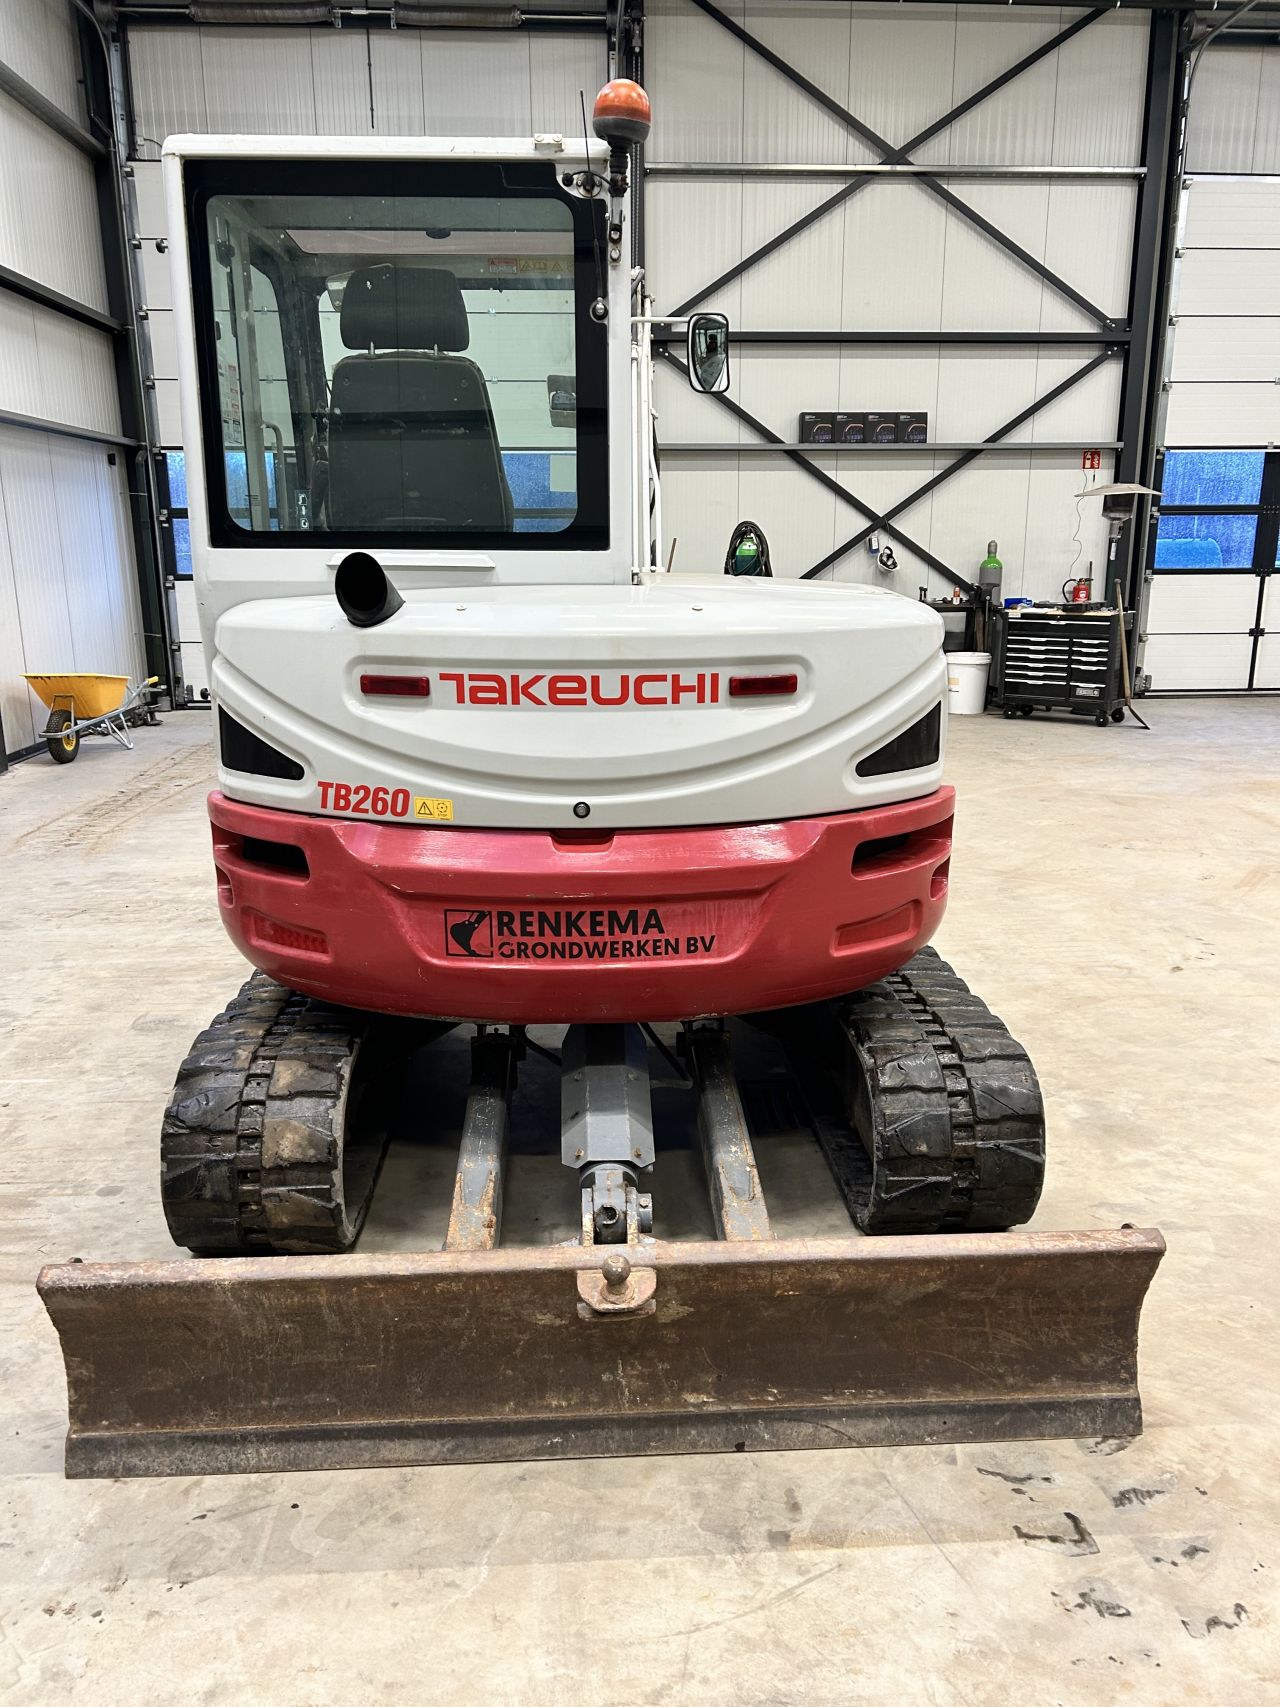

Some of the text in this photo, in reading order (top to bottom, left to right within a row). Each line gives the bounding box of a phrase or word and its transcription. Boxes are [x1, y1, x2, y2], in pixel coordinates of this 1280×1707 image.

[317, 780, 410, 817] TB260
[497, 909, 665, 937] RENKEMA
[499, 935, 716, 959] GRONDWERKEN BV
